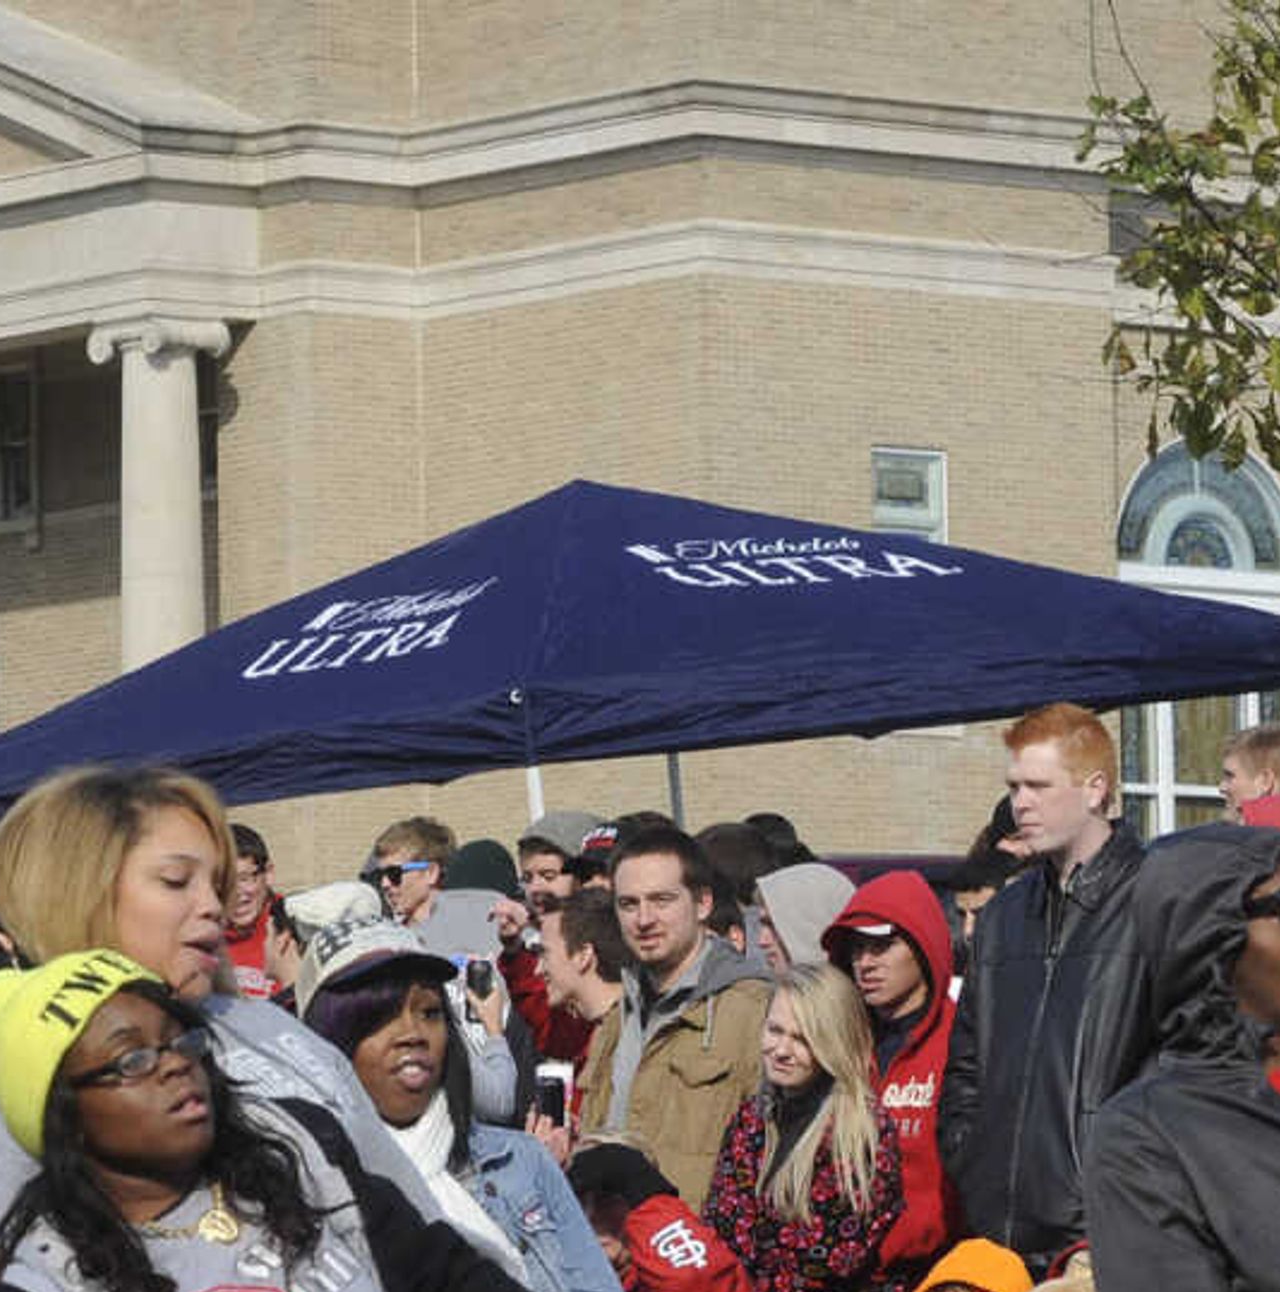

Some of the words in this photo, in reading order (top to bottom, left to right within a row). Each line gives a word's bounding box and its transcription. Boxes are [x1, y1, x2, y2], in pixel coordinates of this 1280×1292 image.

[675, 537, 861, 560] Michelob
[655, 551, 964, 587] ULTRA
[242, 611, 461, 678] ULTRA
